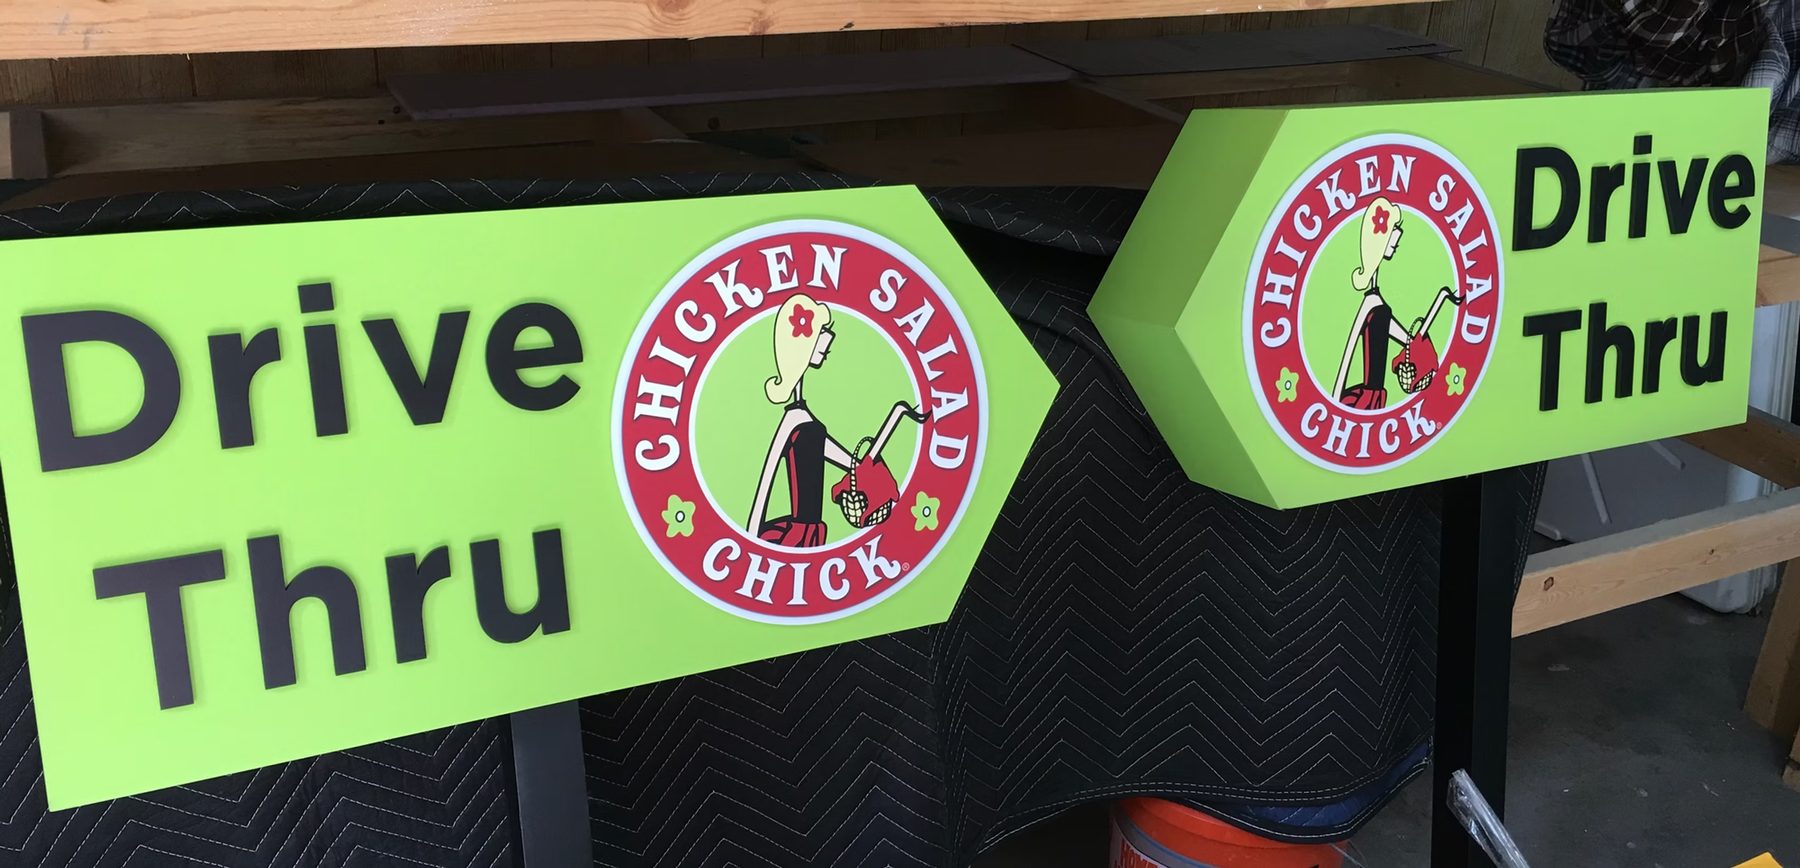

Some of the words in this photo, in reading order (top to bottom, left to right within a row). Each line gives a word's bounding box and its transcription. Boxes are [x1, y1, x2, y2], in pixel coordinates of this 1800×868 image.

[1260, 153, 1416, 349] CHICKEN
[1428, 173, 1494, 346] SALAD
[1511, 132, 1757, 252] Drive
[20, 281, 584, 473] Drive
[633, 243, 848, 472] CHICKEN
[868, 268, 972, 470] SALAD
[1300, 398, 1437, 459] CHICK
[1522, 301, 1729, 412] Thru
[92, 527, 571, 711] Thru
[702, 533, 901, 606] CHICK
